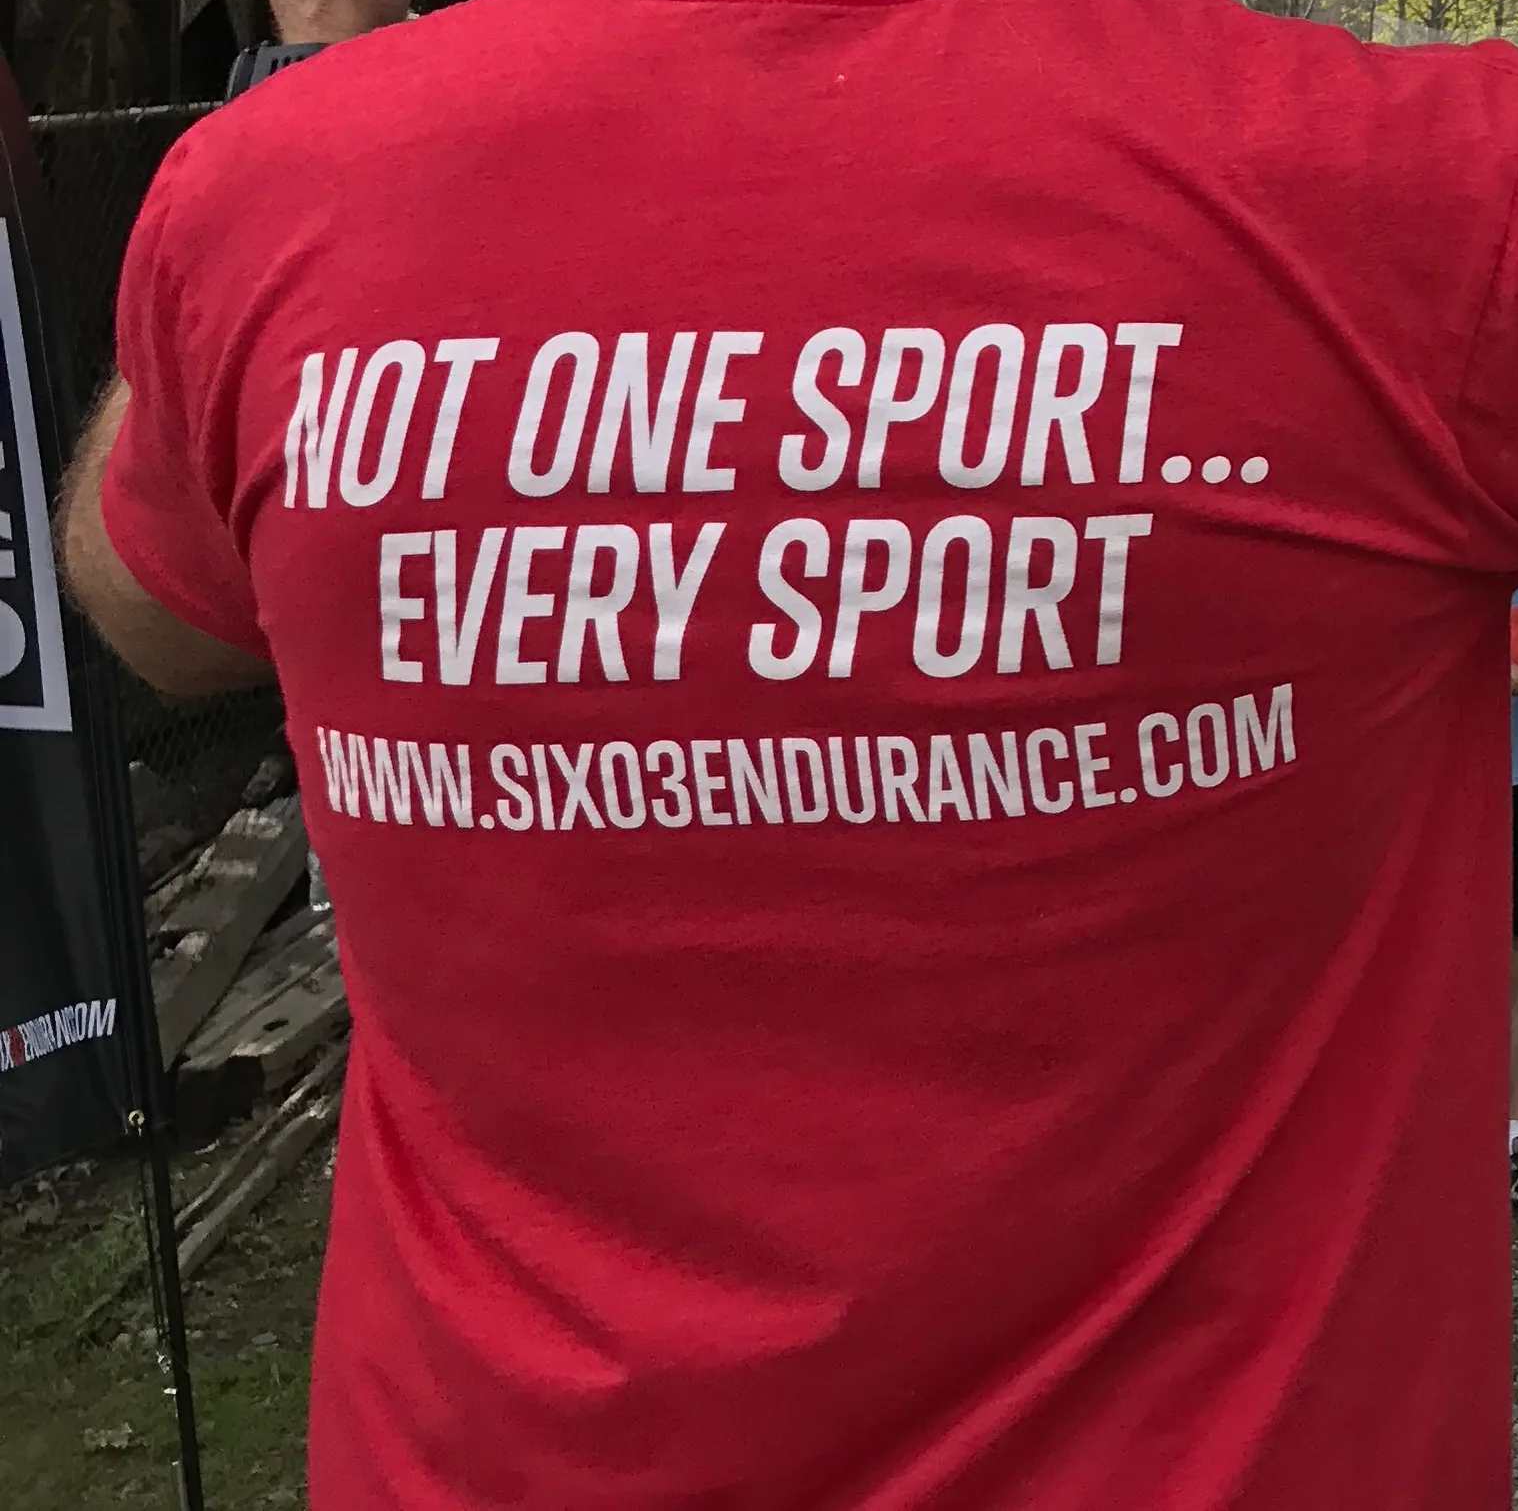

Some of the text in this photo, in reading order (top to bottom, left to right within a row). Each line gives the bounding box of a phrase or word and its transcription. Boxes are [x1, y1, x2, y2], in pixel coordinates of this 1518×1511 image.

[284, 322, 1269, 510] NOT ONE SPORT...
[379, 513, 1154, 686] EVERY SPORT
[316, 683, 1296, 831] WWW.SIX03ENDURANCE.COM
